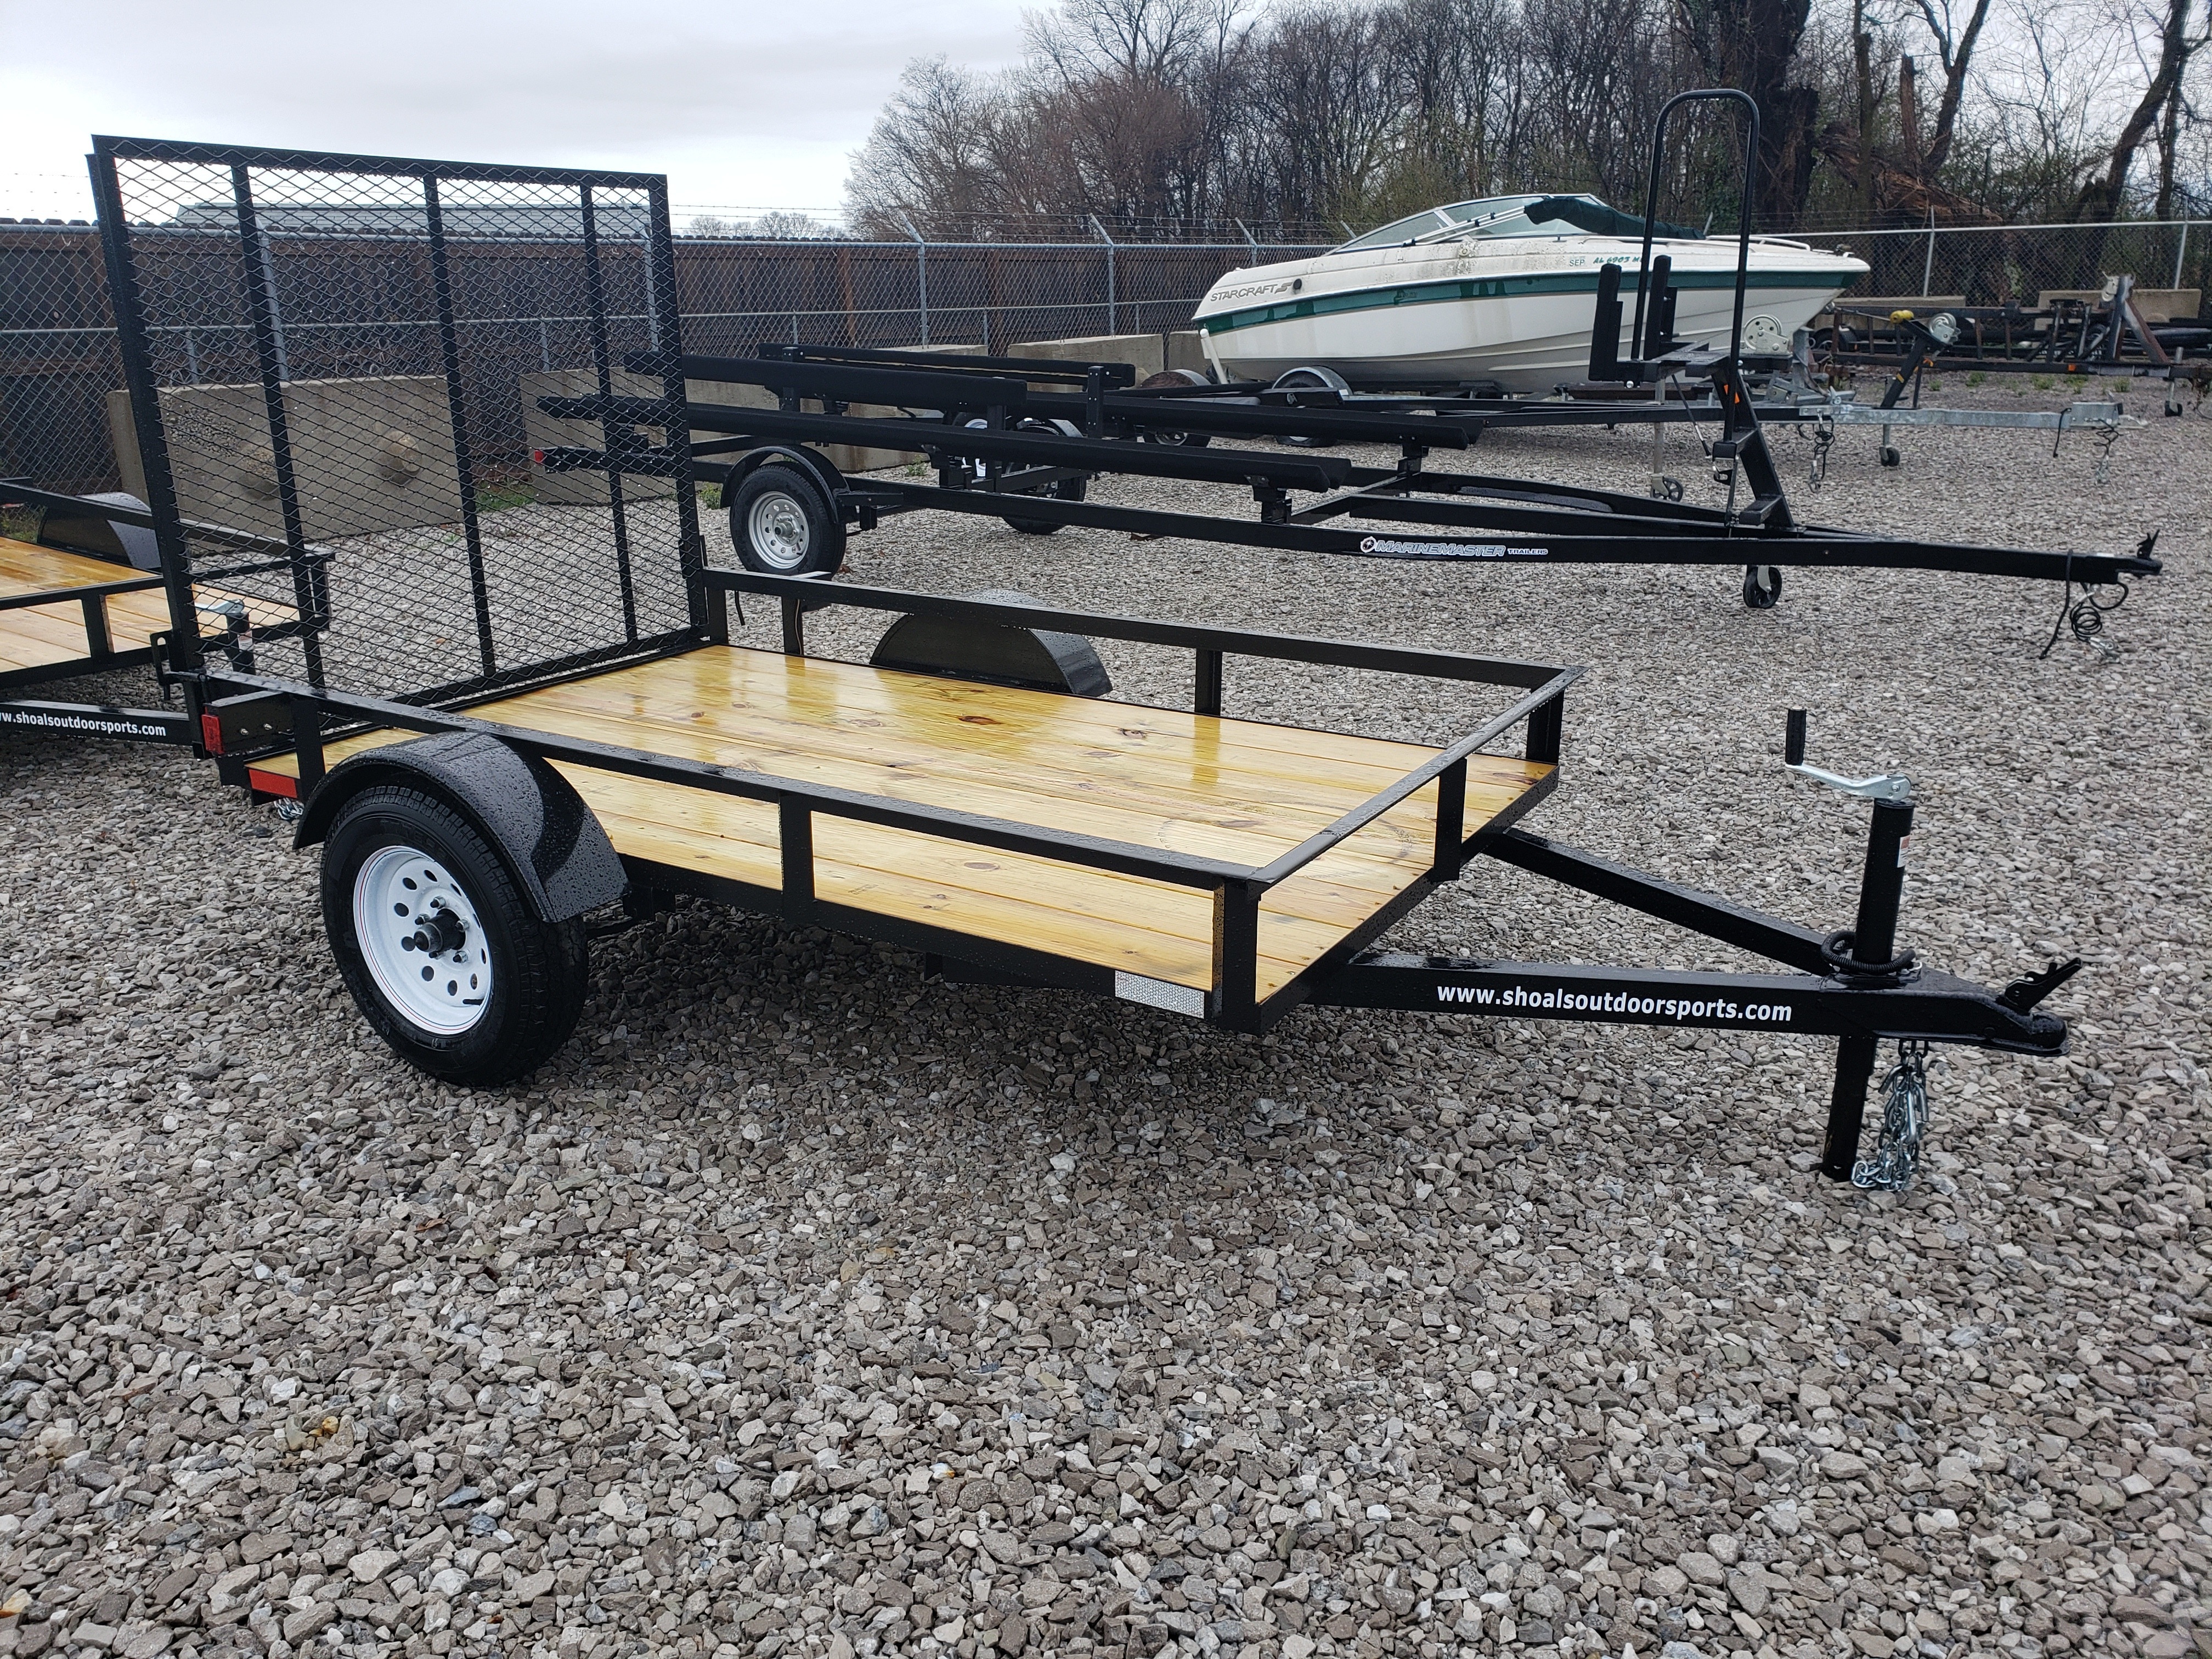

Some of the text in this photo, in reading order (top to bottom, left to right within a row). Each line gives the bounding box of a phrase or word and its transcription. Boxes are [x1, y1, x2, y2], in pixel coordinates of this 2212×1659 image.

[1210, 284, 1278, 302] STARCRAFT
[1376, 540, 1505, 556] MARINEMASTER
[0, 711, 167, 736] w.shoalsoutdoorsports.com
[1437, 986, 1792, 1022] www.shoalsoutdoorsports.com
